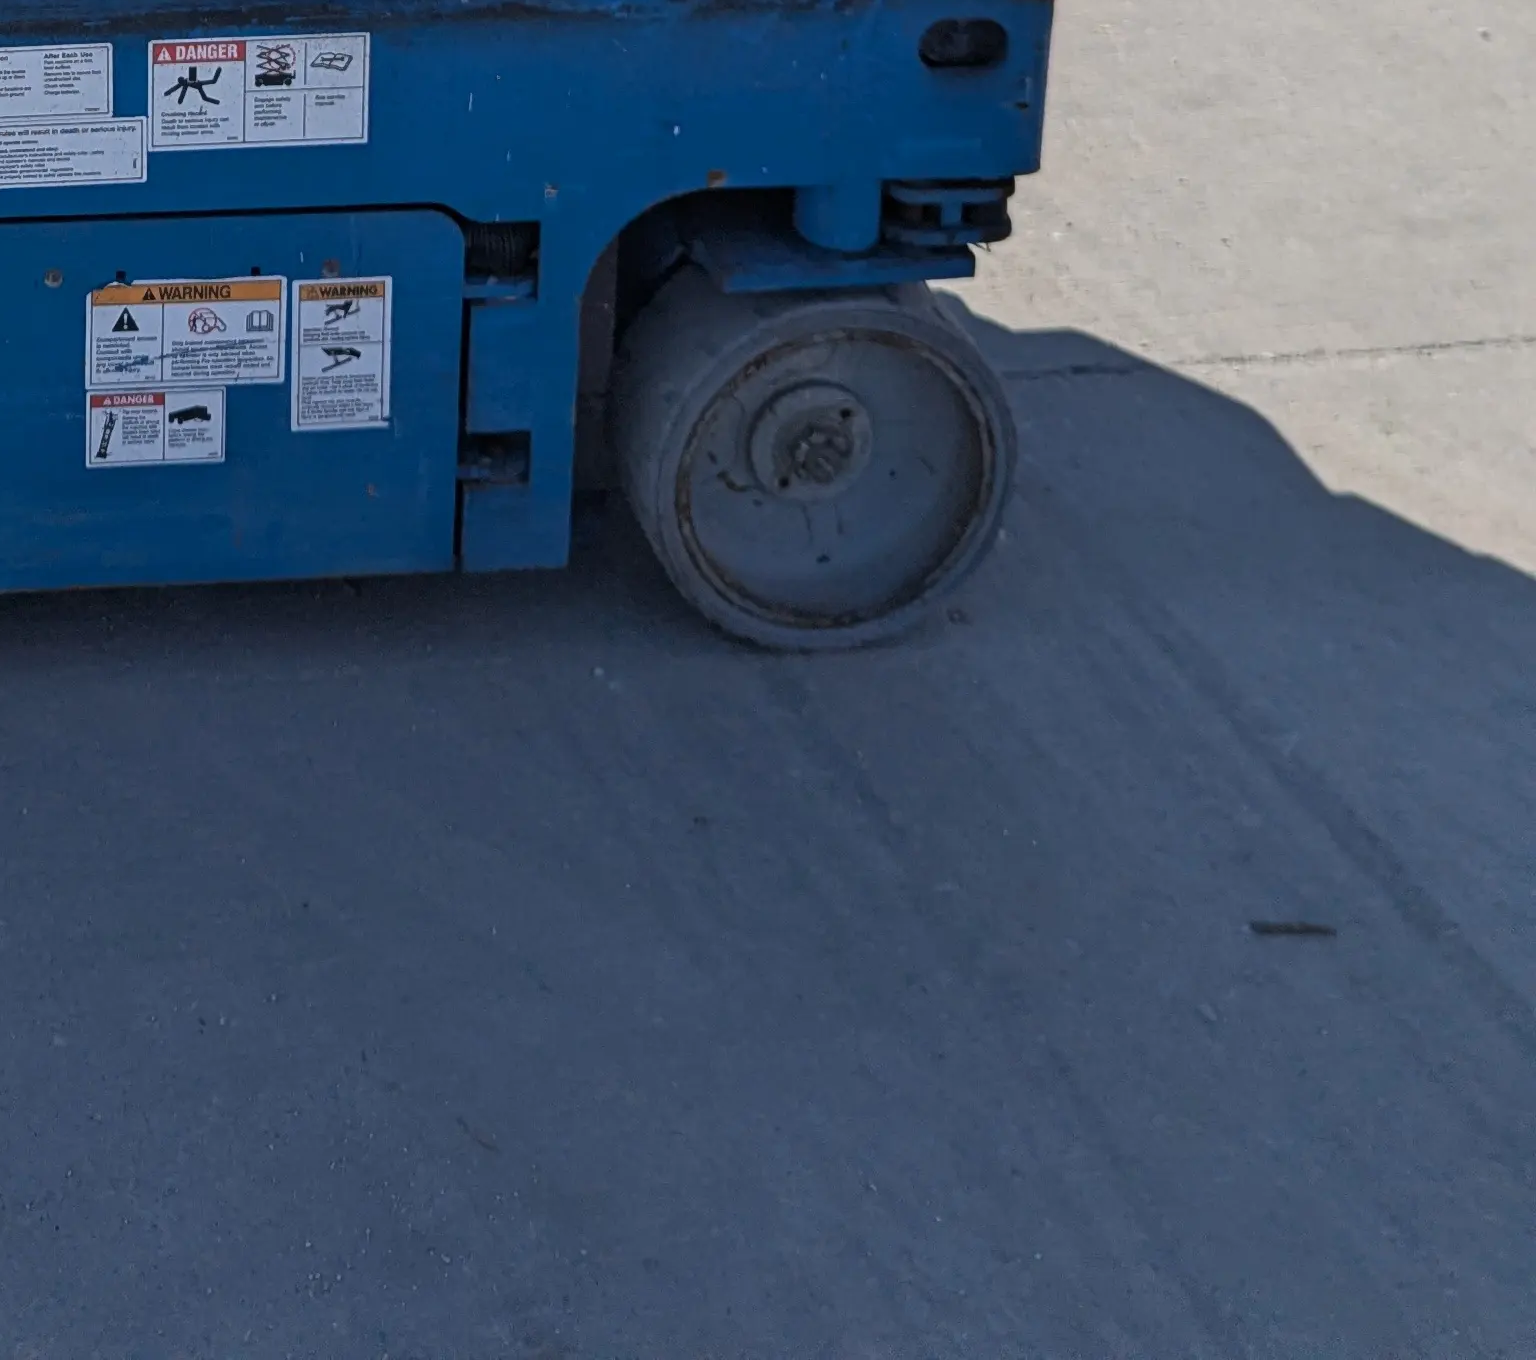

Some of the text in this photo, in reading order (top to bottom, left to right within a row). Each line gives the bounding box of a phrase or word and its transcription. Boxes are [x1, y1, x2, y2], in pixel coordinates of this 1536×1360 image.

[175, 43, 238, 61] DANGER
[158, 284, 232, 300] WARNING
[319, 284, 378, 298] WARNING
[113, 394, 154, 405] DANGER
